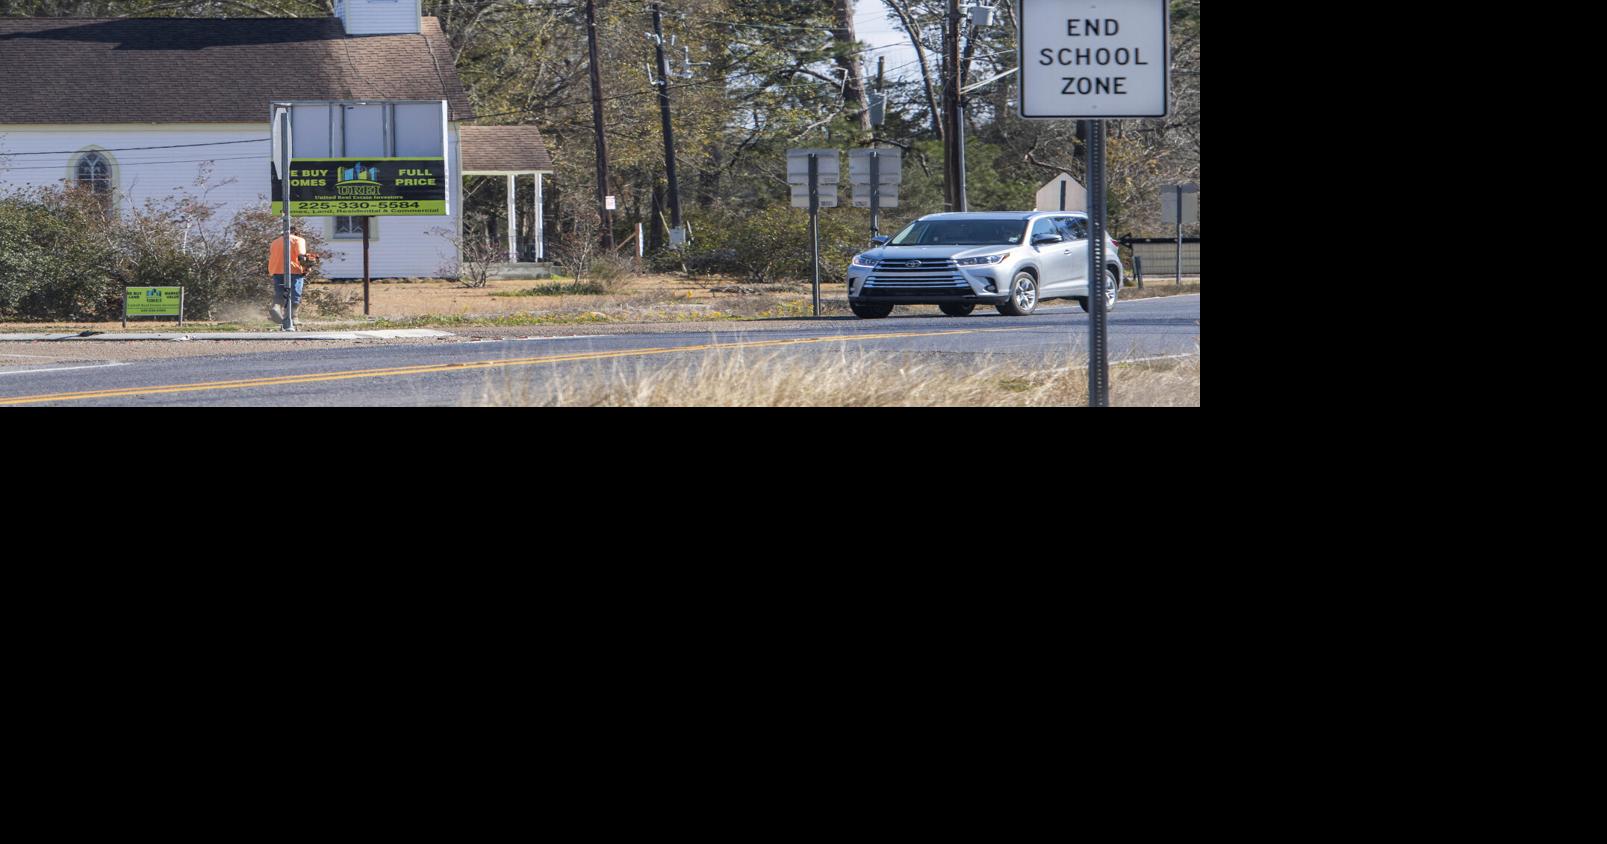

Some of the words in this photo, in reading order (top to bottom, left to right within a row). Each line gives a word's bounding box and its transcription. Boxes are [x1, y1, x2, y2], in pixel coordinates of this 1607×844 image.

[1066, 18, 1119, 37] END
[1039, 47, 1149, 66] SCHOOL
[1060, 76, 1128, 95] ZONE
[302, 169, 329, 177] BUY
[398, 169, 433, 177] FULL
[290, 178, 327, 188] OMES
[395, 178, 437, 187] PRICE
[298, 201, 420, 210] 225-330-5584
